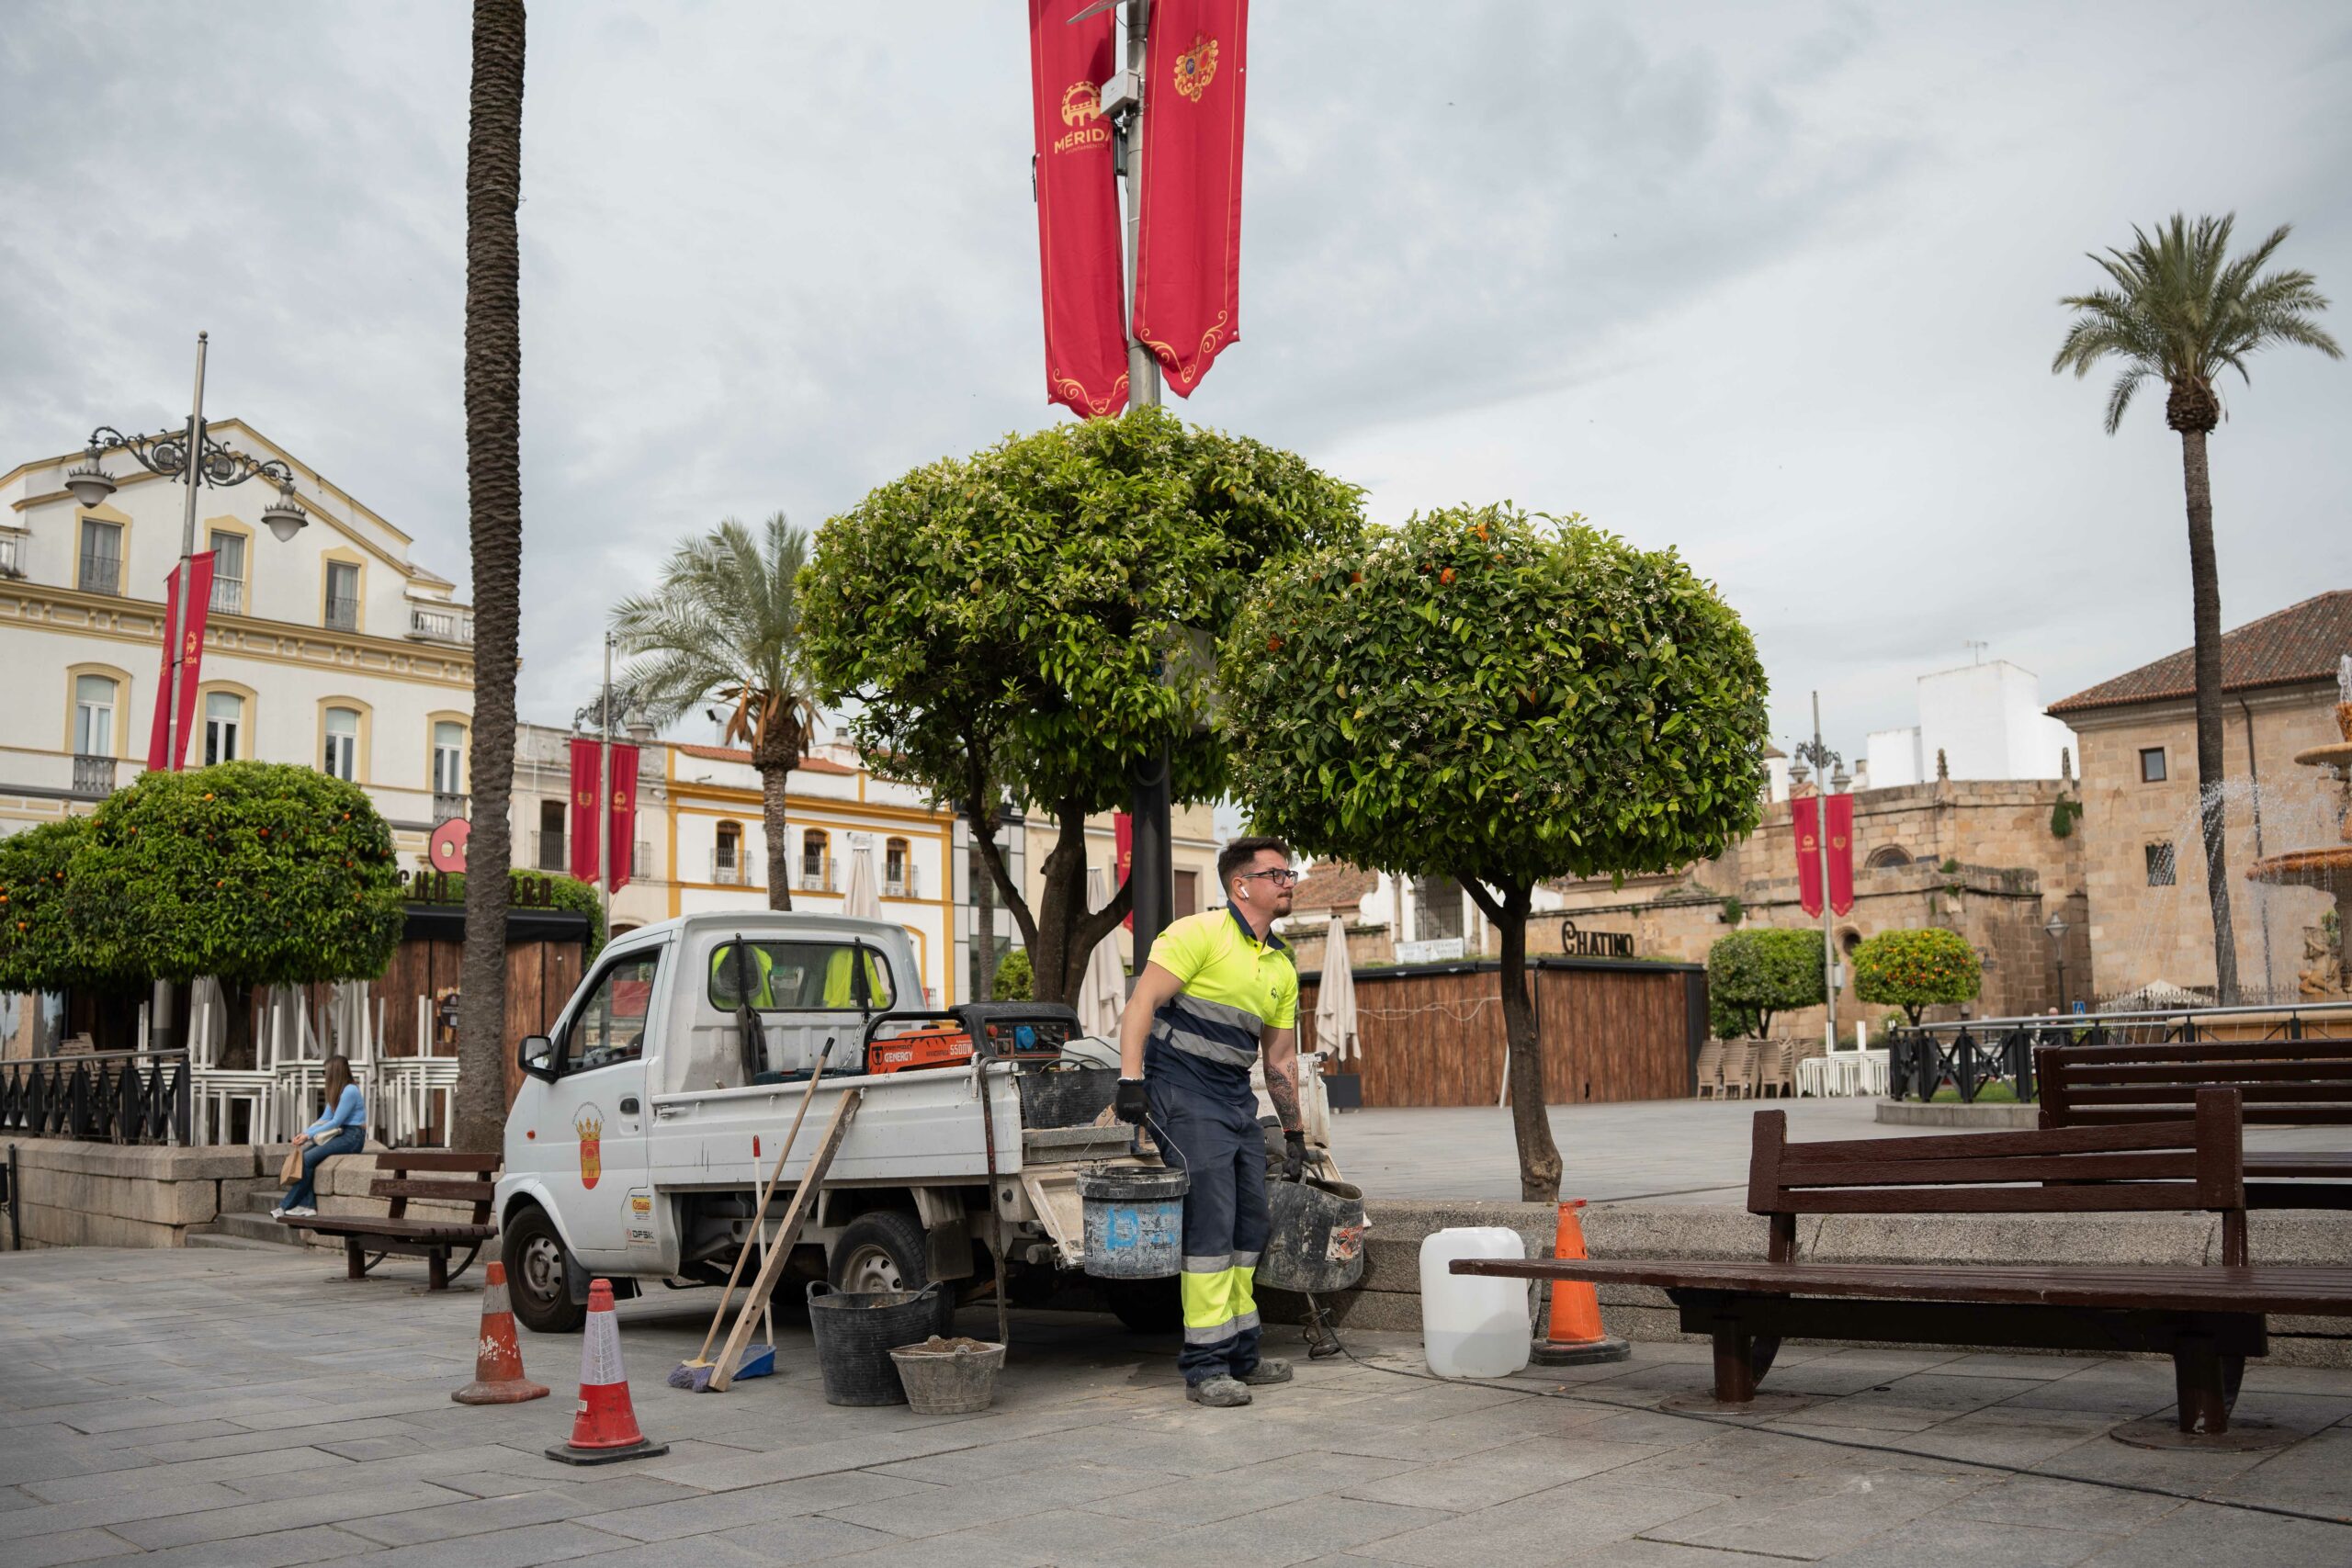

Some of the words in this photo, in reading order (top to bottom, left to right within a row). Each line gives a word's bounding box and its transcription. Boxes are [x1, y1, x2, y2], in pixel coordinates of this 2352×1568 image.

[398, 870, 448, 903] CHO
[507, 876, 552, 906] RRO
[1562, 920, 1634, 957] CHATINO
[884, 1051, 913, 1063] GENERGY
[950, 1043, 973, 1055] 5500W
[632, 1230, 654, 1239] DFSK
